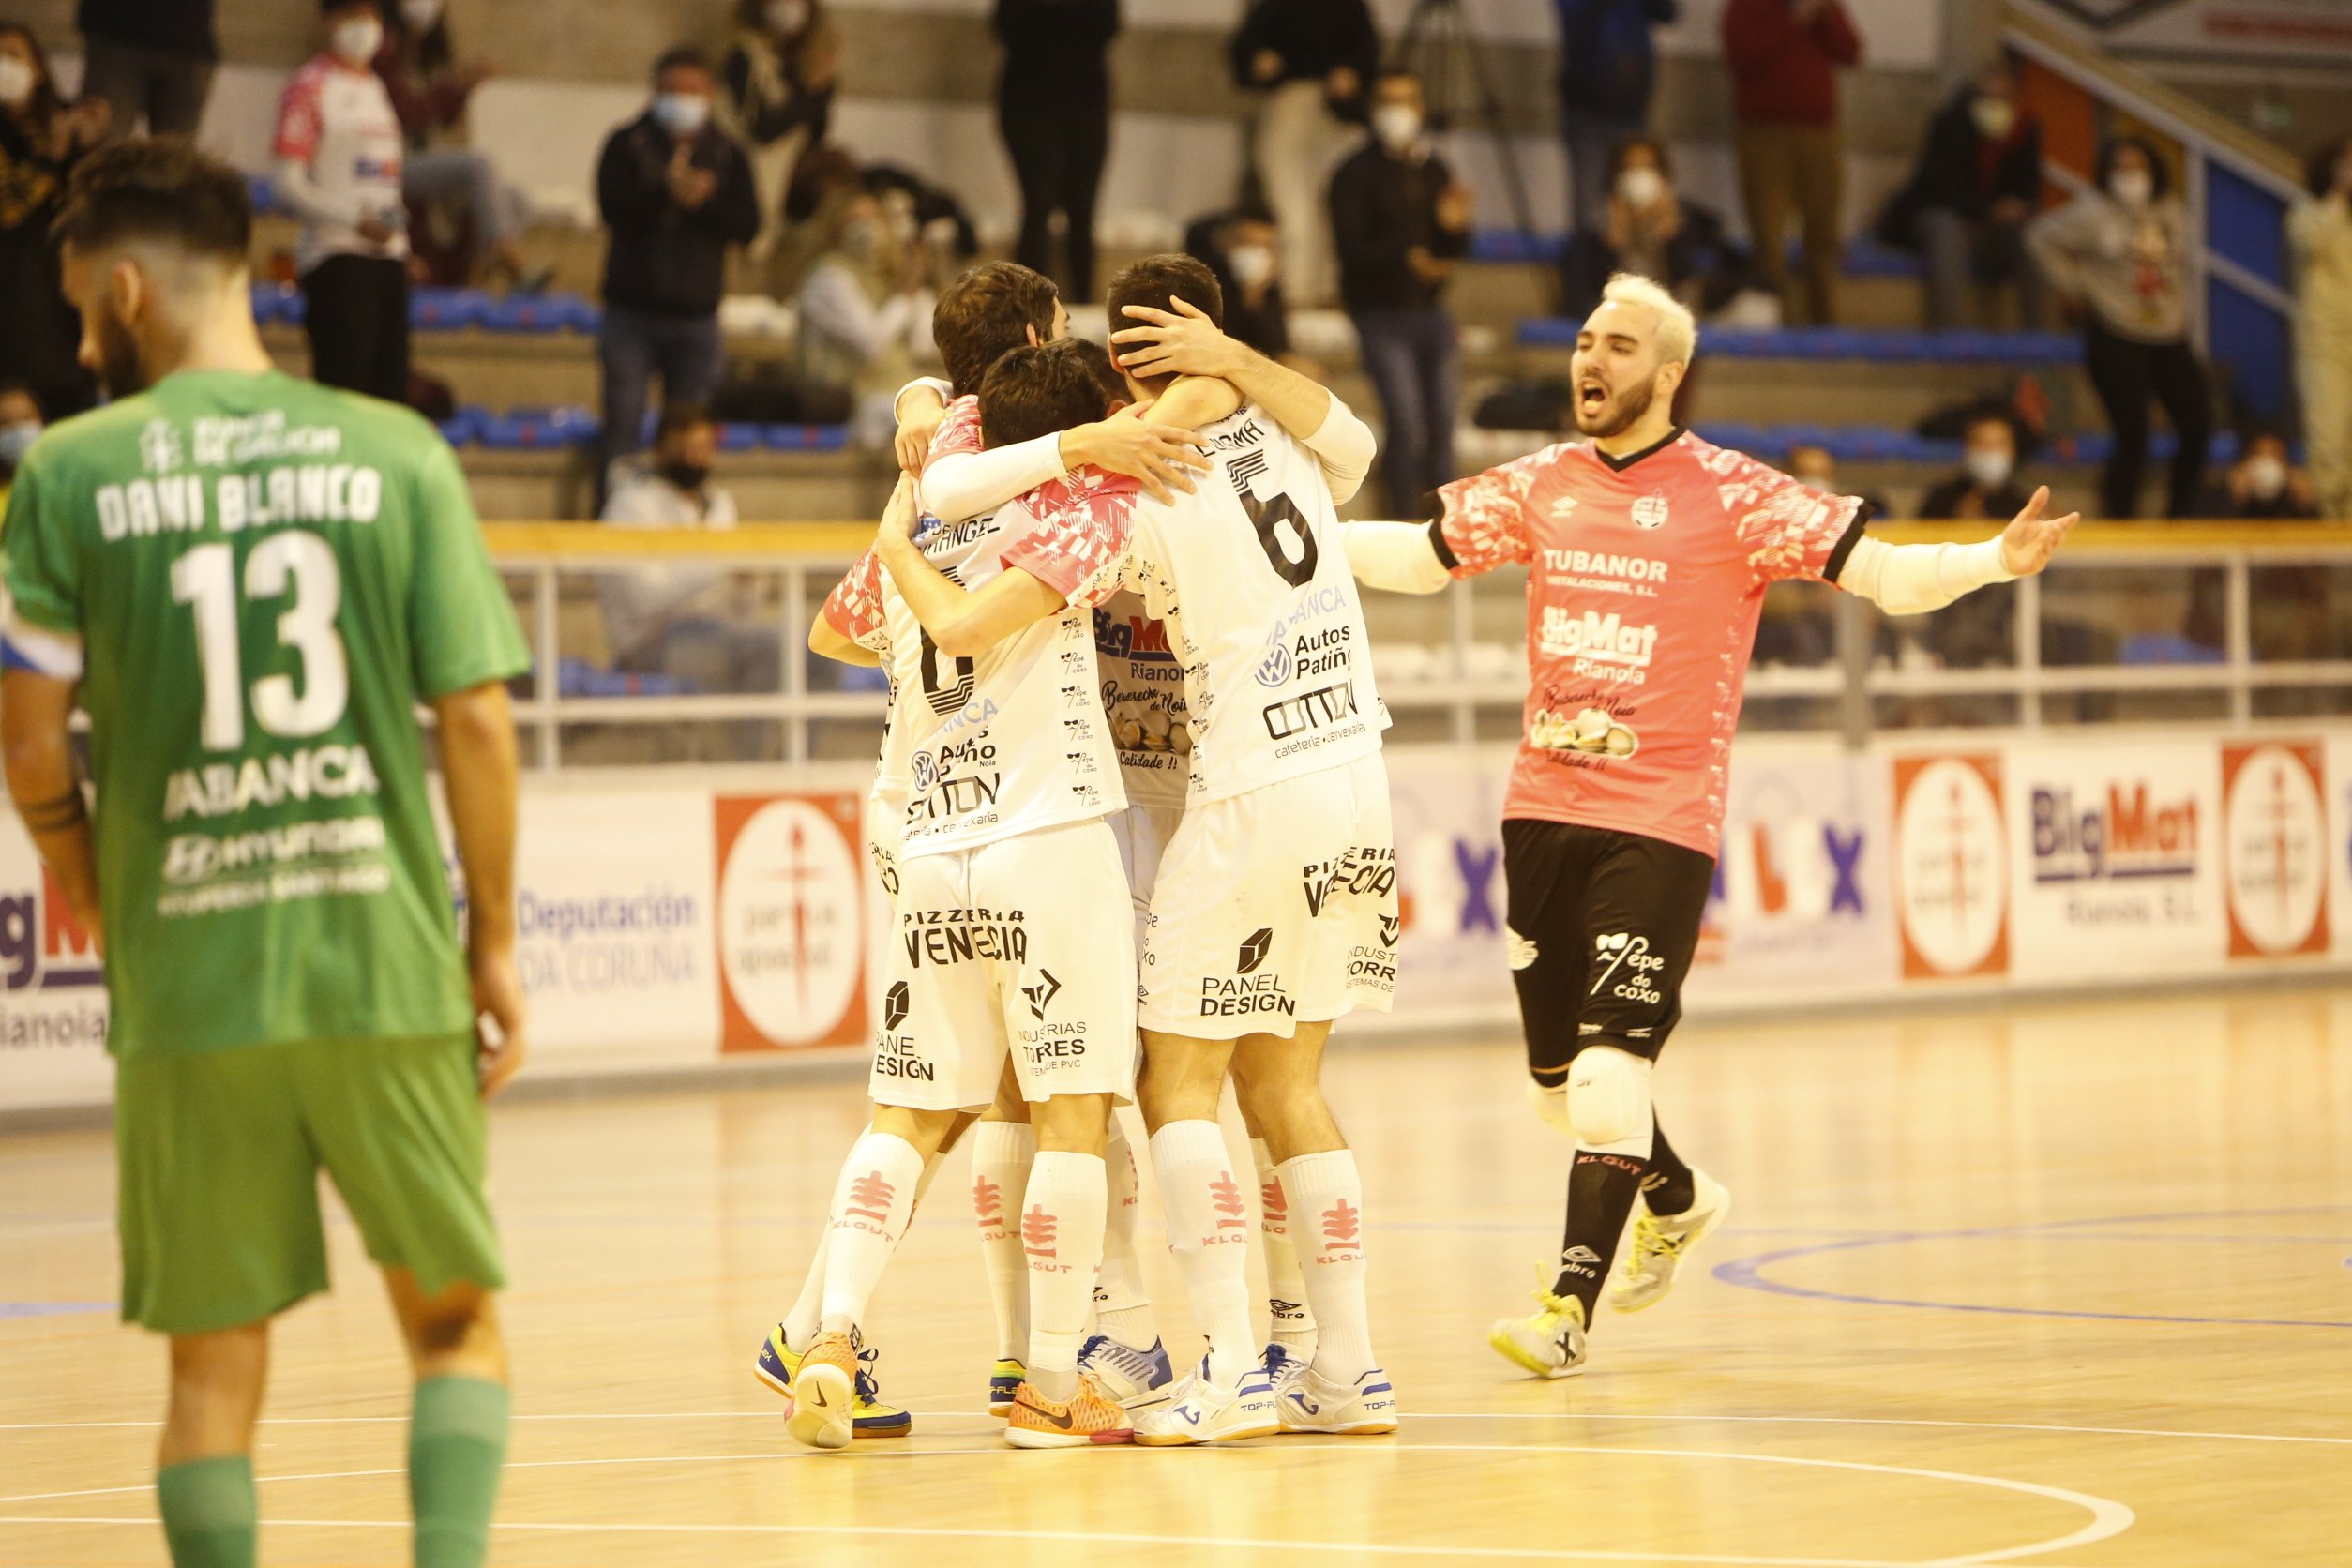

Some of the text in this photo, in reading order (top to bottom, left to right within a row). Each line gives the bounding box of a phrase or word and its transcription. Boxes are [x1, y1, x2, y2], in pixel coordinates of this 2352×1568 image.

[97, 464, 382, 541] DANI BLANCO
[1226, 448, 1318, 588] 6
[1544, 549, 1668, 582] TUBANOR
[171, 530, 349, 750] 13
[1294, 625, 1349, 656] Autos
[1541, 605, 1658, 656] BigMat
[1296, 646, 1351, 680] Patiñ
[2031, 782, 2199, 878] BigMat
[904, 908, 1025, 927] PIZZERIA
[1202, 973, 1287, 996] PANEL
[1613, 984, 1661, 1004] coxo
[1631, 972, 1651, 988] do
[1200, 994, 1296, 1017] DESIGN
[876, 1055, 934, 1081] ESIGN
